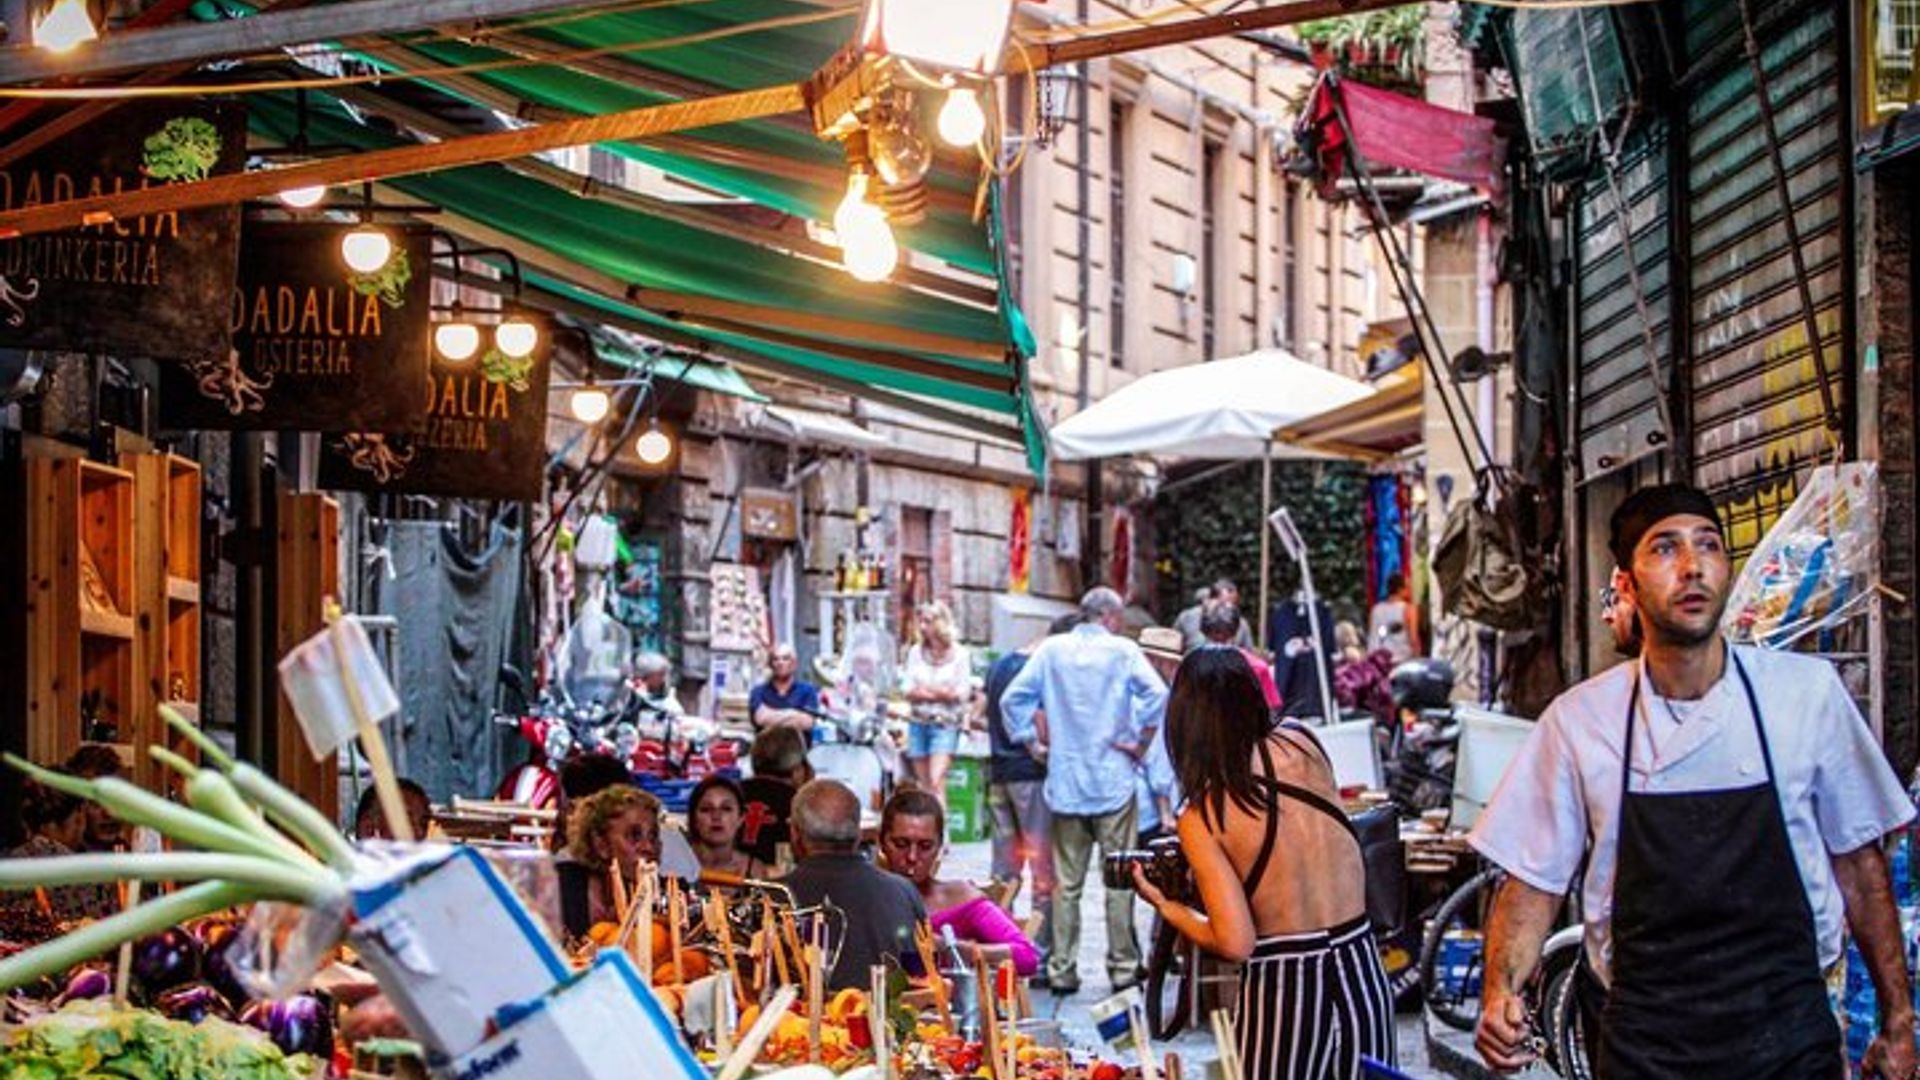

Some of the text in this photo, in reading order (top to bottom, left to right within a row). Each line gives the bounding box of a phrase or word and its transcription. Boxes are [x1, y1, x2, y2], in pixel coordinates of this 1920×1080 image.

[6, 236, 159, 285] DRINKERIA
[229, 286, 381, 336] DADALIA
[255, 338, 351, 375] OSTERIA
